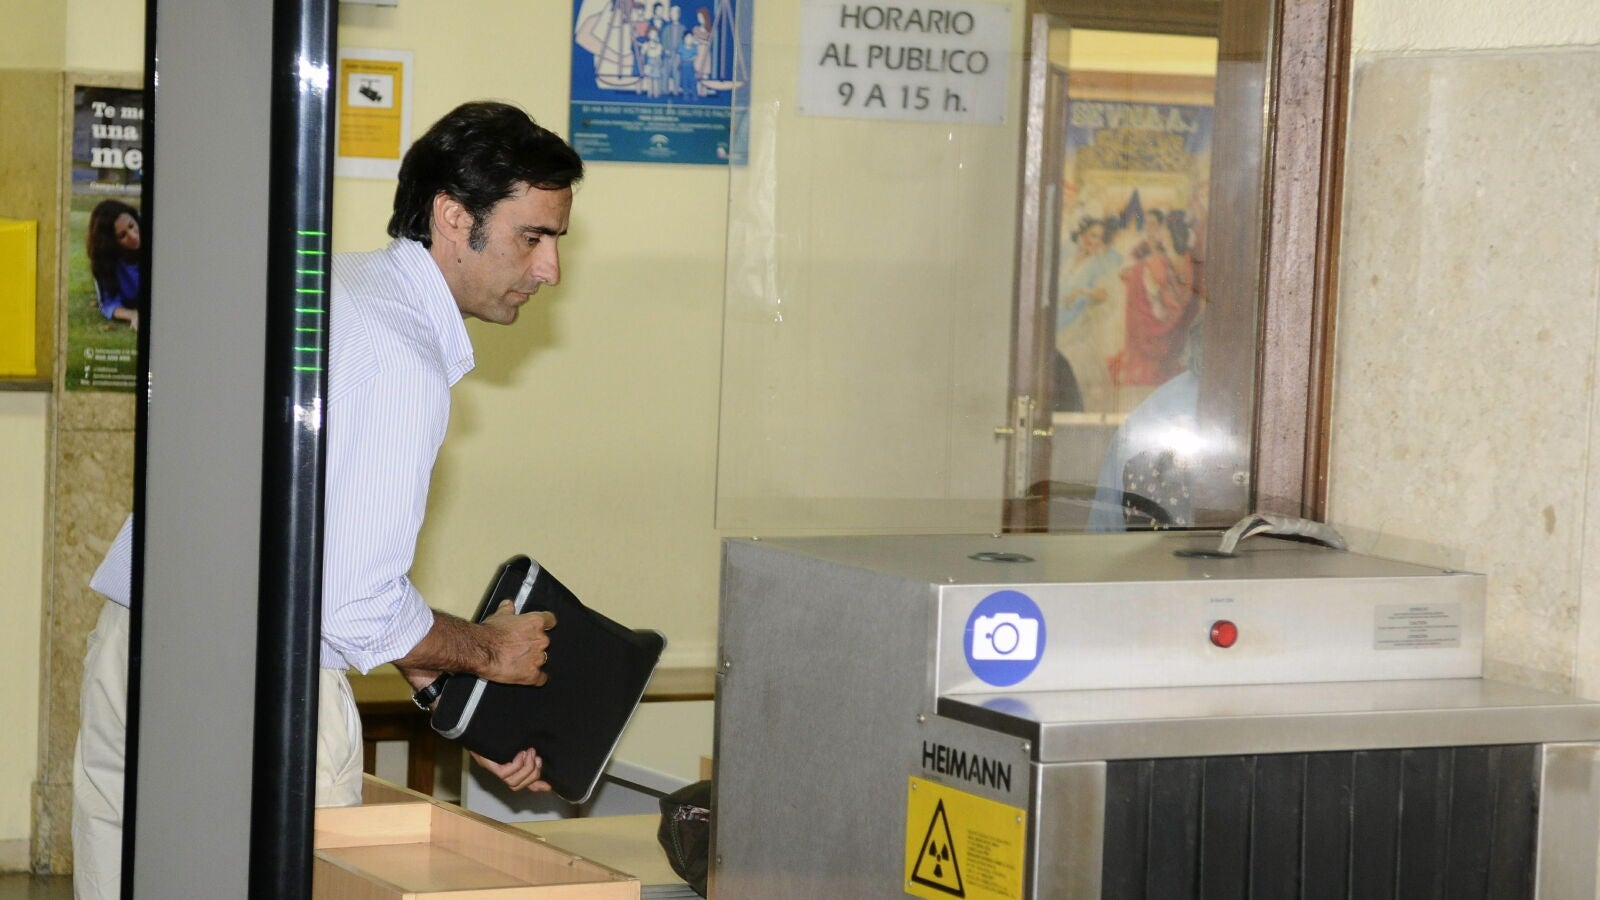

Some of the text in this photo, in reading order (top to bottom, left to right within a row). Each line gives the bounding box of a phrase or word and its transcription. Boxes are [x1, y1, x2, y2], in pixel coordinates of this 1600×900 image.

[840, 4, 975, 35] HORARIO
[819, 43, 990, 74] AL PUBLICO
[91, 101, 116, 118] Te
[838, 81, 968, 112] 9 A 15 h.
[91, 123, 138, 141] una
[90, 147, 143, 172] me
[922, 740, 1012, 792] HEIMANN
